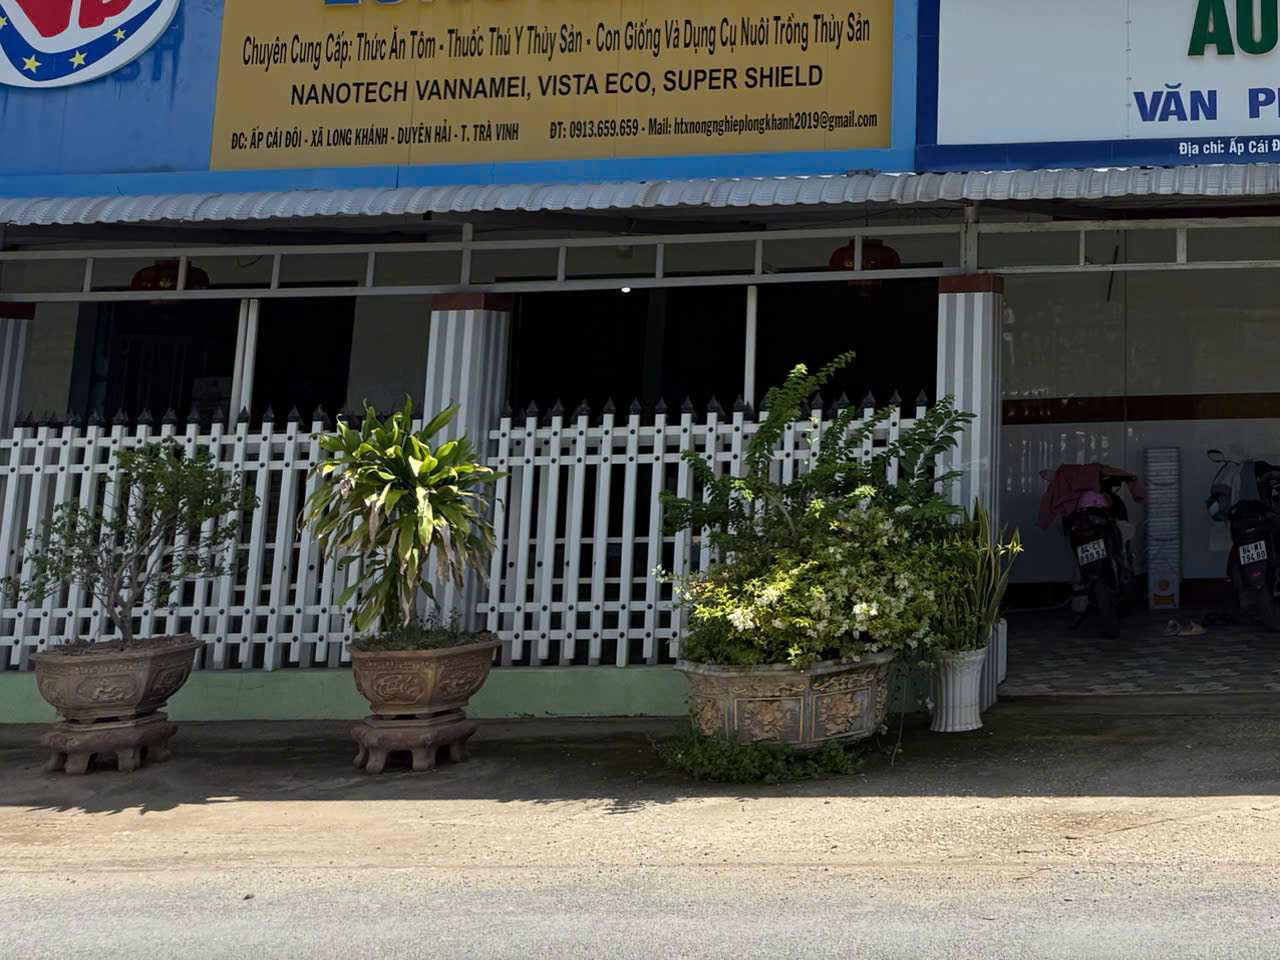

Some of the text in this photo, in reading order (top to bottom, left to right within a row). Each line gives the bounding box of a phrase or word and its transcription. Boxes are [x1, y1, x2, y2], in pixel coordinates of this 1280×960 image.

[243, 35, 287, 72] Chuyên
[290, 34, 322, 71] Cung
[325, 31, 352, 69] Cấp:
[356, 28, 387, 61] Thức
[389, 25, 406, 60] Ăn
[410, 30, 436, 59] Tôm
[447, 25, 484, 57] Thuốc
[489, 24, 511, 57] Thú
[514, 26, 524, 55] Y
[527, 24, 557, 62] Thủy
[559, 24, 582, 54] Sản
[596, 22, 620, 52] Con
[624, 18, 661, 57] Giống
[665, 19, 680, 49] Và
[683, 19, 716, 55] Dụng
[720, 17, 737, 54] Cụ
[740, 16, 769, 47] Nuôi
[773, 12, 809, 52] Trồng
[813, 13, 844, 50] Thủy
[847, 12, 870, 42] Sản
[290, 64, 823, 105] NANOTECH VANNAMEI, VISTA ECO, SUPER SHIELD
[1133, 83, 1217, 122] VĂN
[249, 127, 264, 149] ẤP
[266, 127, 282, 149] CÁI
[285, 125, 301, 148] ĐÔI
[310, 126, 323, 147] XÃ
[326, 128, 352, 147] LONG
[354, 124, 388, 146] KHÁNH
[397, 122, 432, 144] DUYÊN
[434, 120, 451, 142] HẢI
[473, 120, 493, 142] TRÀ
[496, 123, 520, 141] VINH
[550, 121, 566, 139] ĐT:
[569, 118, 639, 138] 0913.659.659
[648, 117, 672, 136] Mail:
[674, 110, 878, 137] htxnongnghieplongkhanh2019@gmail.com
[1179, 142, 1199, 158] Địa
[1203, 139, 1225, 154] chỉ:
[1229, 137, 1245, 156] Ấp
[1248, 139, 1269, 154] Cái
